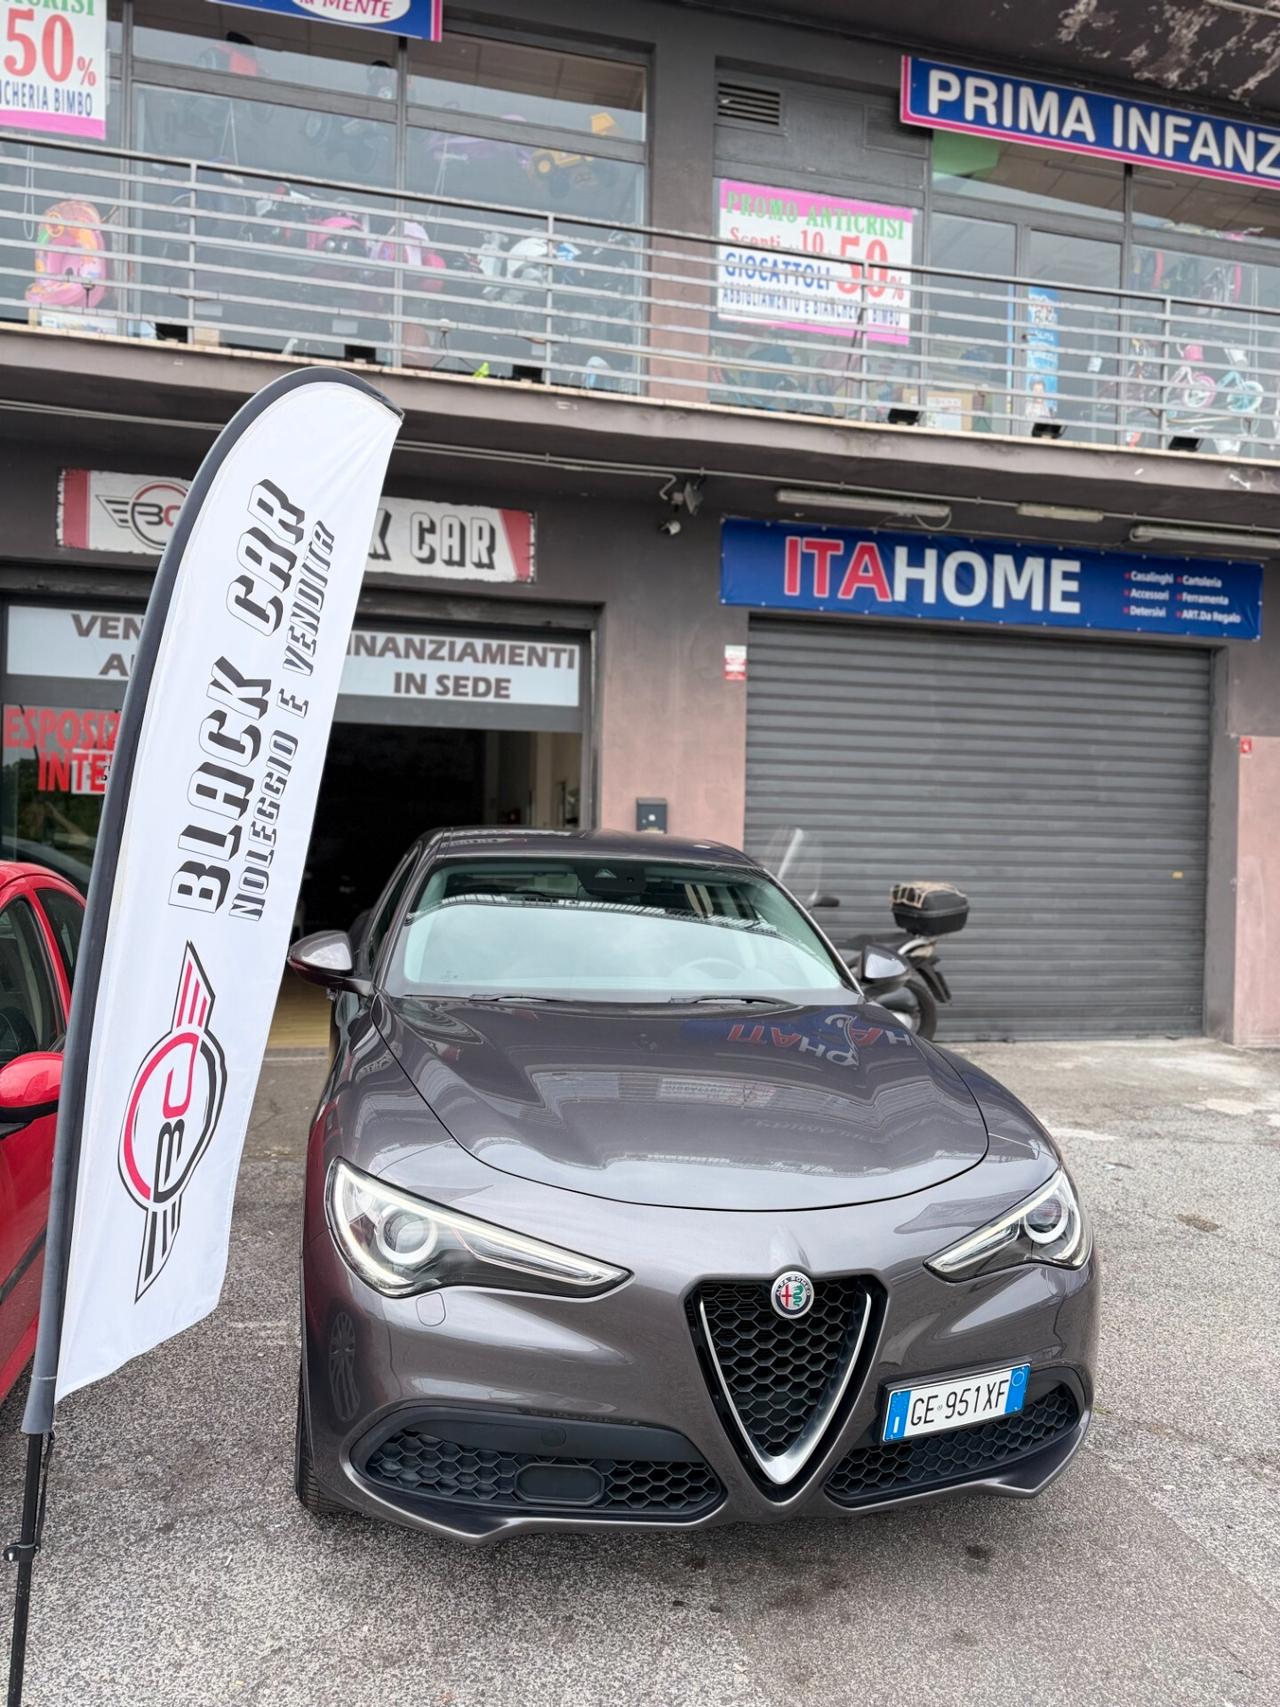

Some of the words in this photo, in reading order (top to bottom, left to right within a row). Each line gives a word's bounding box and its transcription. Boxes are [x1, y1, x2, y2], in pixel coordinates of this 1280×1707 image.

[0, 79, 49, 111] CHERIA
[54, 87, 93, 117] BIMBO
[928, 69, 1096, 143] PRIMA
[726, 191, 799, 223] PROMO
[806, 206, 905, 240] ANTICRISI
[725, 252, 830, 290] GIOCATTOLI
[410, 511, 496, 570] CAR
[784, 536, 1081, 614] ITAHOME
[1130, 571, 1174, 586] Casalinghi
[1182, 575, 1222, 588] Cartoleria
[282, 520, 335, 677] VENDITA
[1129, 606, 1166, 618] Detersivi
[1130, 588, 1169, 601] Accessori
[1182, 592, 1229, 605] Ferramenta
[71, 613, 144, 640] VEN
[346, 633, 575, 669] INANZIAMENTI
[168, 655, 271, 914] BLACK
[225, 479, 305, 637] CAR
[276, 688, 309, 719] E
[393, 672, 427, 695] IN
[435, 674, 511, 699] SEDE
[4, 707, 121, 750] ESPOSIZ
[37, 751, 112, 792] INTE
[228, 729, 298, 921] NOLEGGIO
